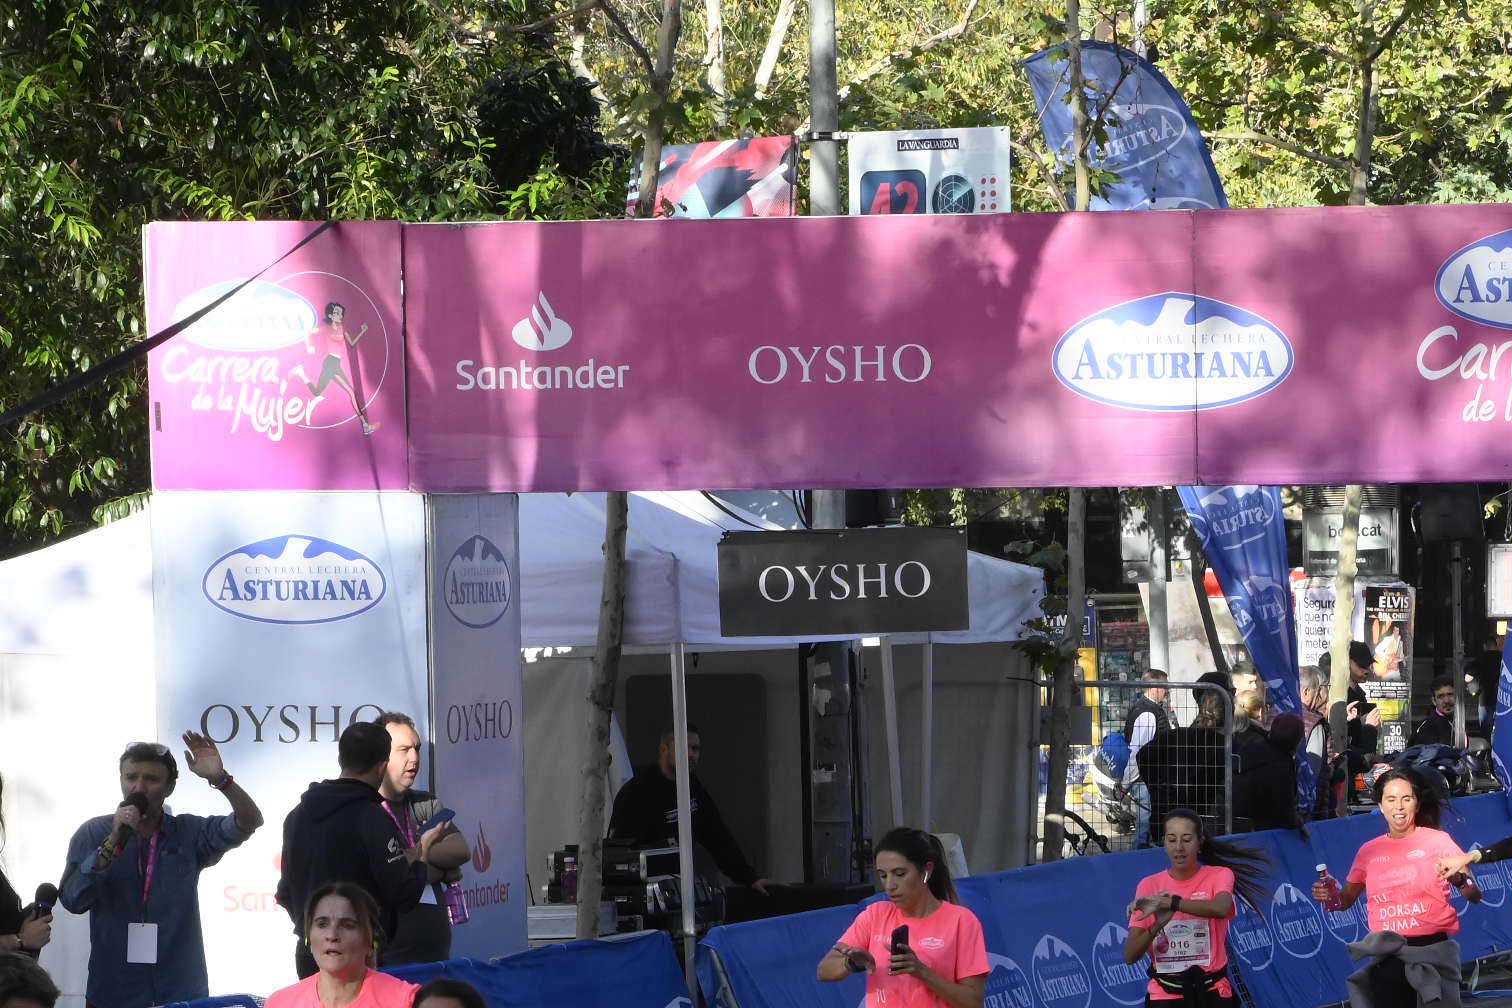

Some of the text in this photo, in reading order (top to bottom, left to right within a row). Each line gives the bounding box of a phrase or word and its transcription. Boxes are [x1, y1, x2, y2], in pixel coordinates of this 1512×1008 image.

[1192, 332, 1267, 345] LECHERA
[160, 346, 280, 384] Carrera
[456, 358, 631, 391] Santander
[748, 344, 932, 385] OYSHO
[1072, 337, 1275, 380] ASTURIANA
[230, 380, 325, 442] Mujer
[1462, 383, 1495, 423] de
[218, 567, 373, 602] ASTURIANA
[244, 565, 367, 575] CENTRAL LECHERA
[449, 570, 507, 605] ASTURIANA
[758, 560, 931, 603] OYSHO
[1378, 596, 1409, 609] ELVIS
[446, 700, 513, 745] OYSHO
[1379, 901, 1427, 921] DORSAL
[1169, 940, 1191, 950] 016
[1039, 969, 1089, 1001] ASTURIANA
